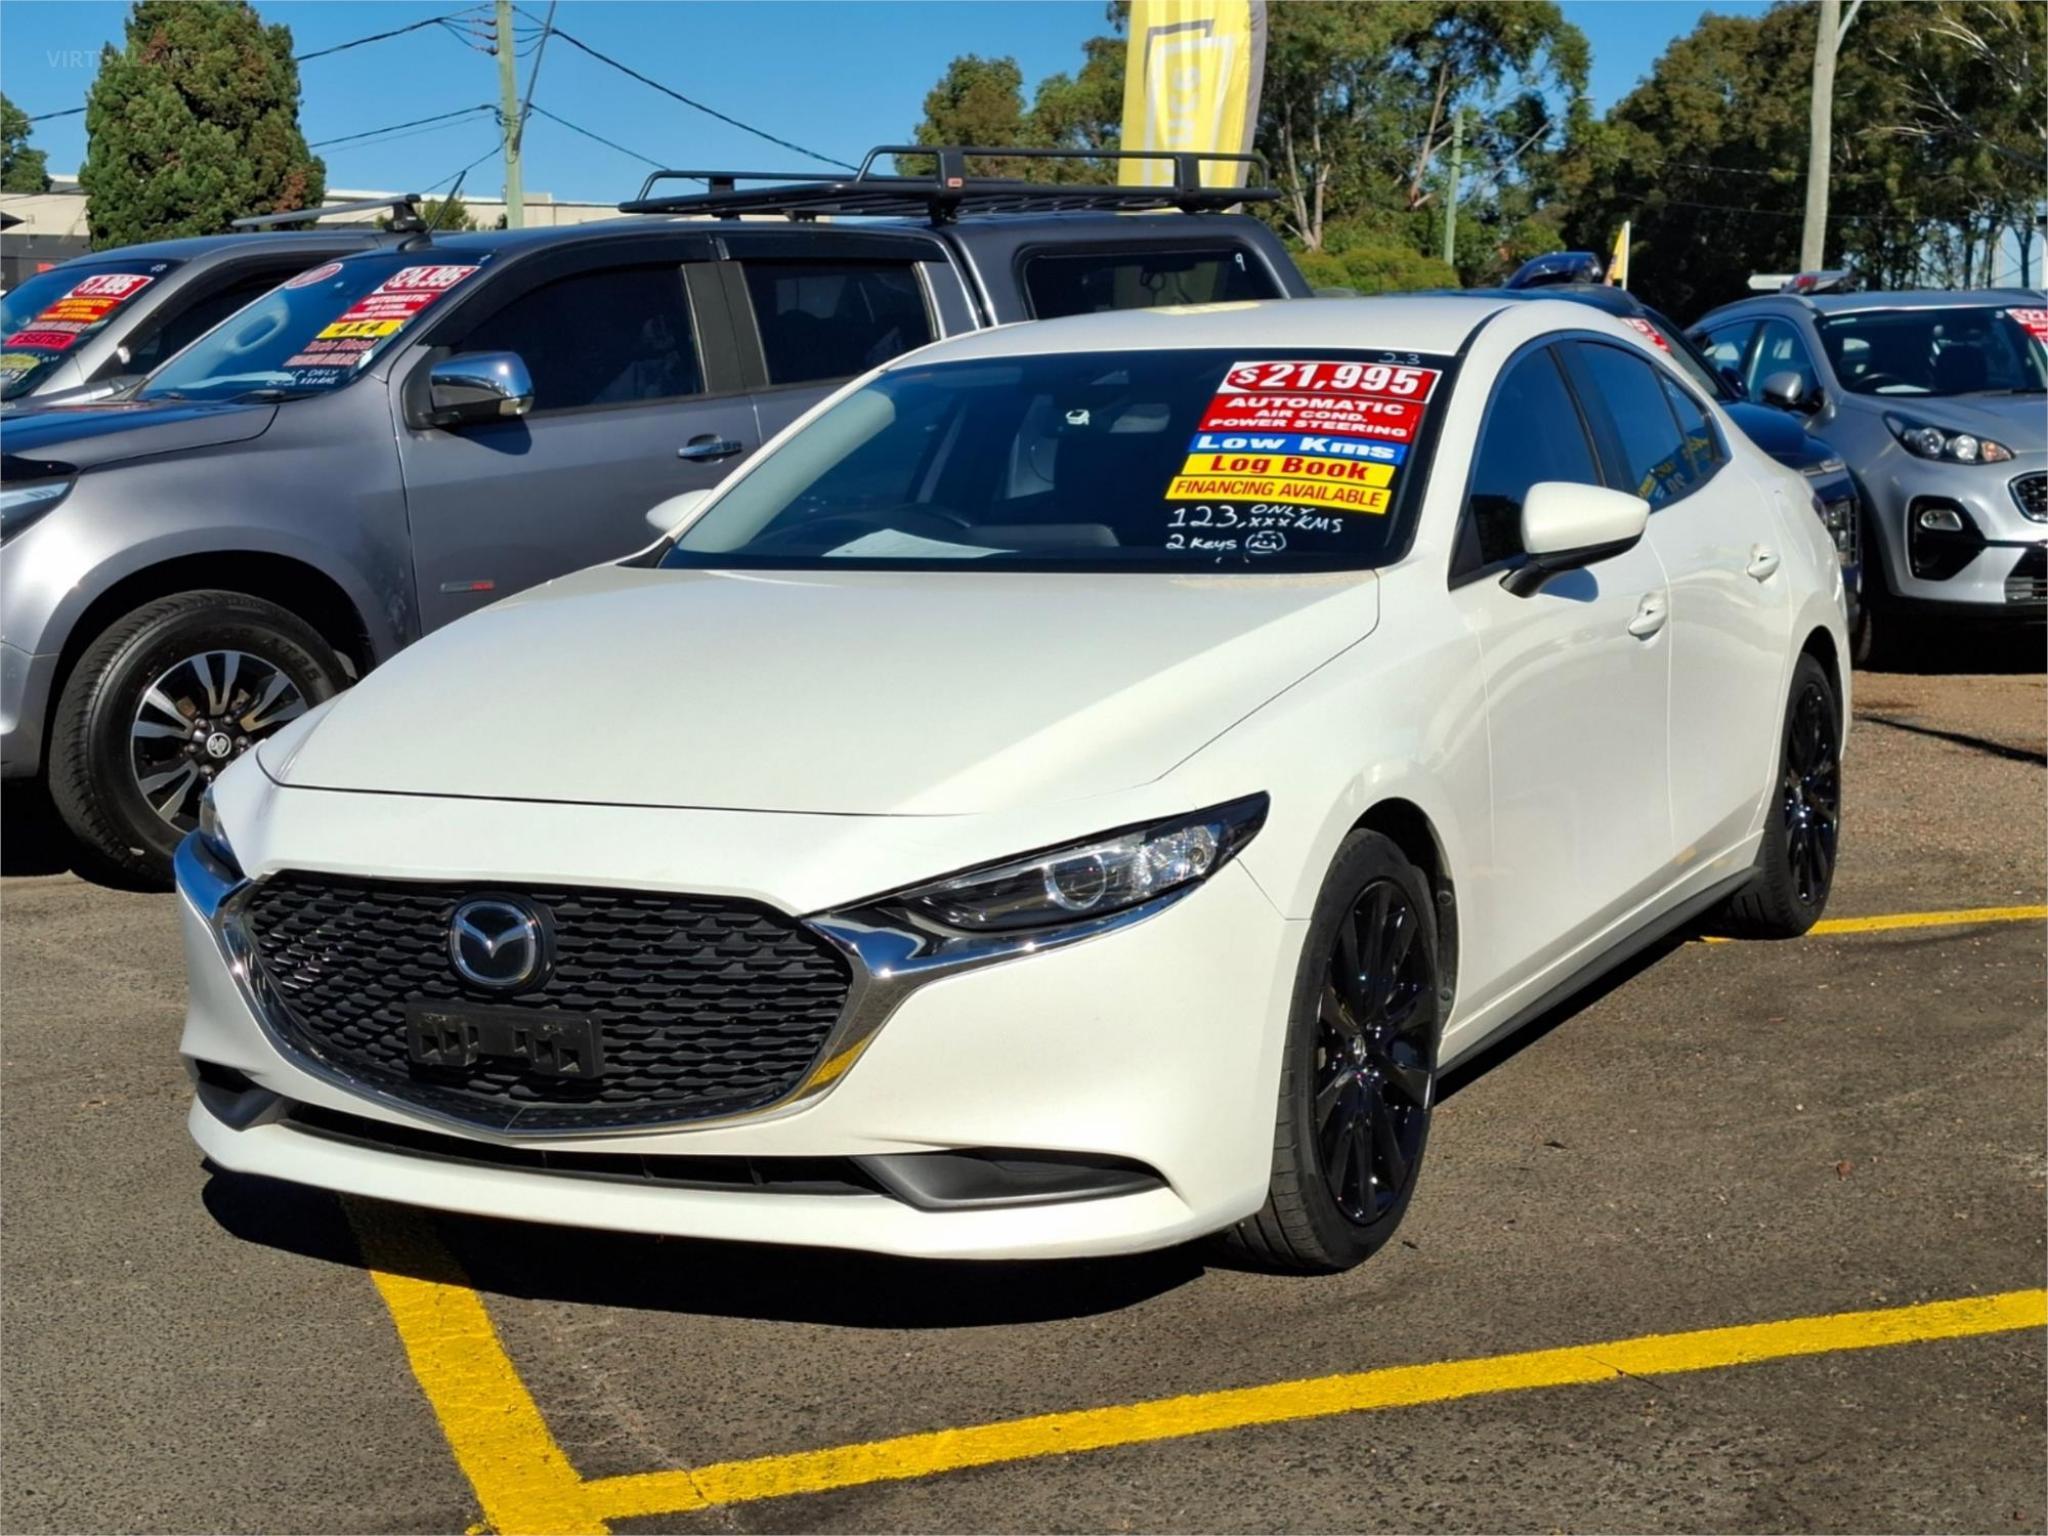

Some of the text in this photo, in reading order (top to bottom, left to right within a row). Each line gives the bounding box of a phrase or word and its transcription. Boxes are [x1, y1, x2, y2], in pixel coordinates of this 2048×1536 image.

[1234, 363, 1423, 395] $21,995
[1226, 397, 1405, 416] AUTOMATIC
[1254, 409, 1368, 422] AIR COND.
[1208, 418, 1408, 437] POWER STEERING
[1299, 437, 1395, 459] Kms
[1210, 455, 1370, 481] Log Book
[1174, 479, 1384, 508] FINANCING AVAILABLE
[1250, 504, 1316, 518] ONLY
[1165, 533, 1186, 550] 2
